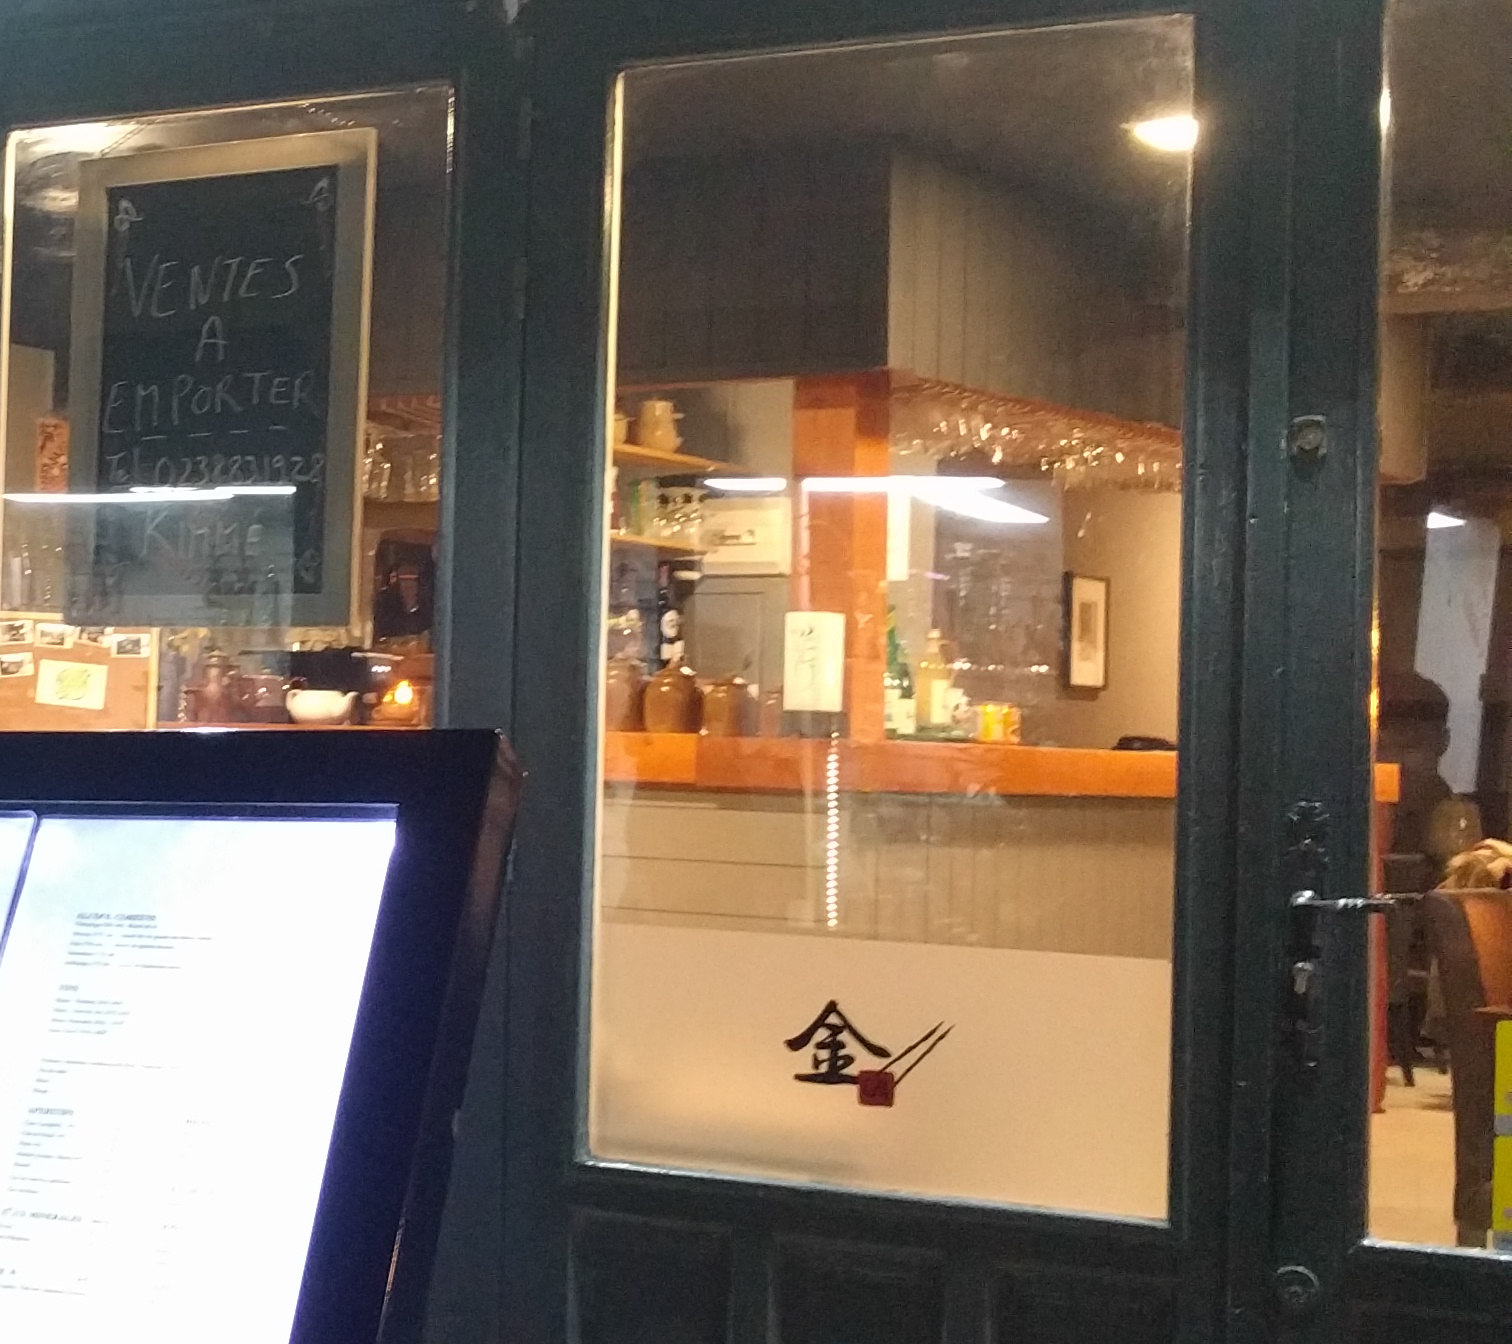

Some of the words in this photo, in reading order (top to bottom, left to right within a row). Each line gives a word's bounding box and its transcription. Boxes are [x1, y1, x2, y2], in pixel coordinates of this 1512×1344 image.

[122, 253, 306, 318] VENTES
[193, 315, 229, 363] A
[102, 369, 316, 434] EMPORTER
